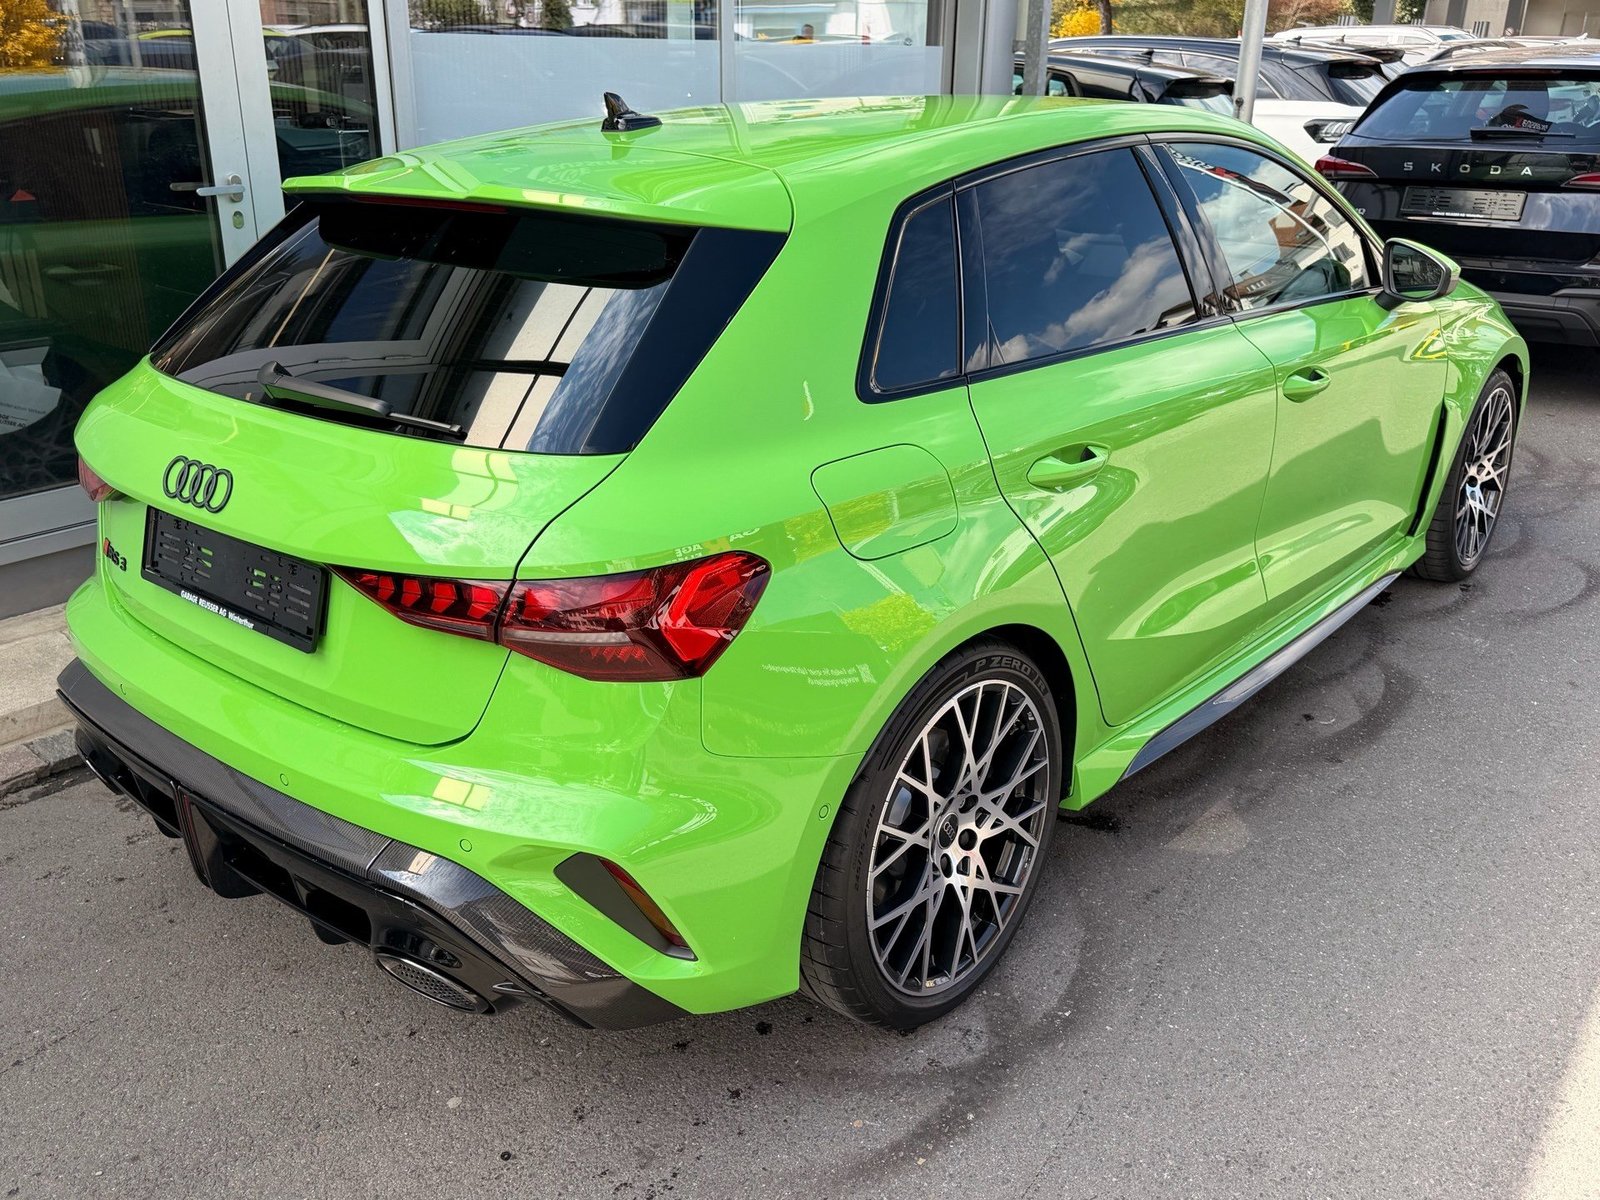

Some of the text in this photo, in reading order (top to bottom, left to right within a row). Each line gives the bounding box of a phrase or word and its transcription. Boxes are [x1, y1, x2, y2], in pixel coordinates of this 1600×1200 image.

[1403, 161, 1532, 176] SKODA
[120, 558, 127, 572] 3
[181, 590, 254, 629] GARAGE REUSSER AG Winterthur
[974, 659, 986, 673] P
[989, 656, 1031, 674] ZERO
